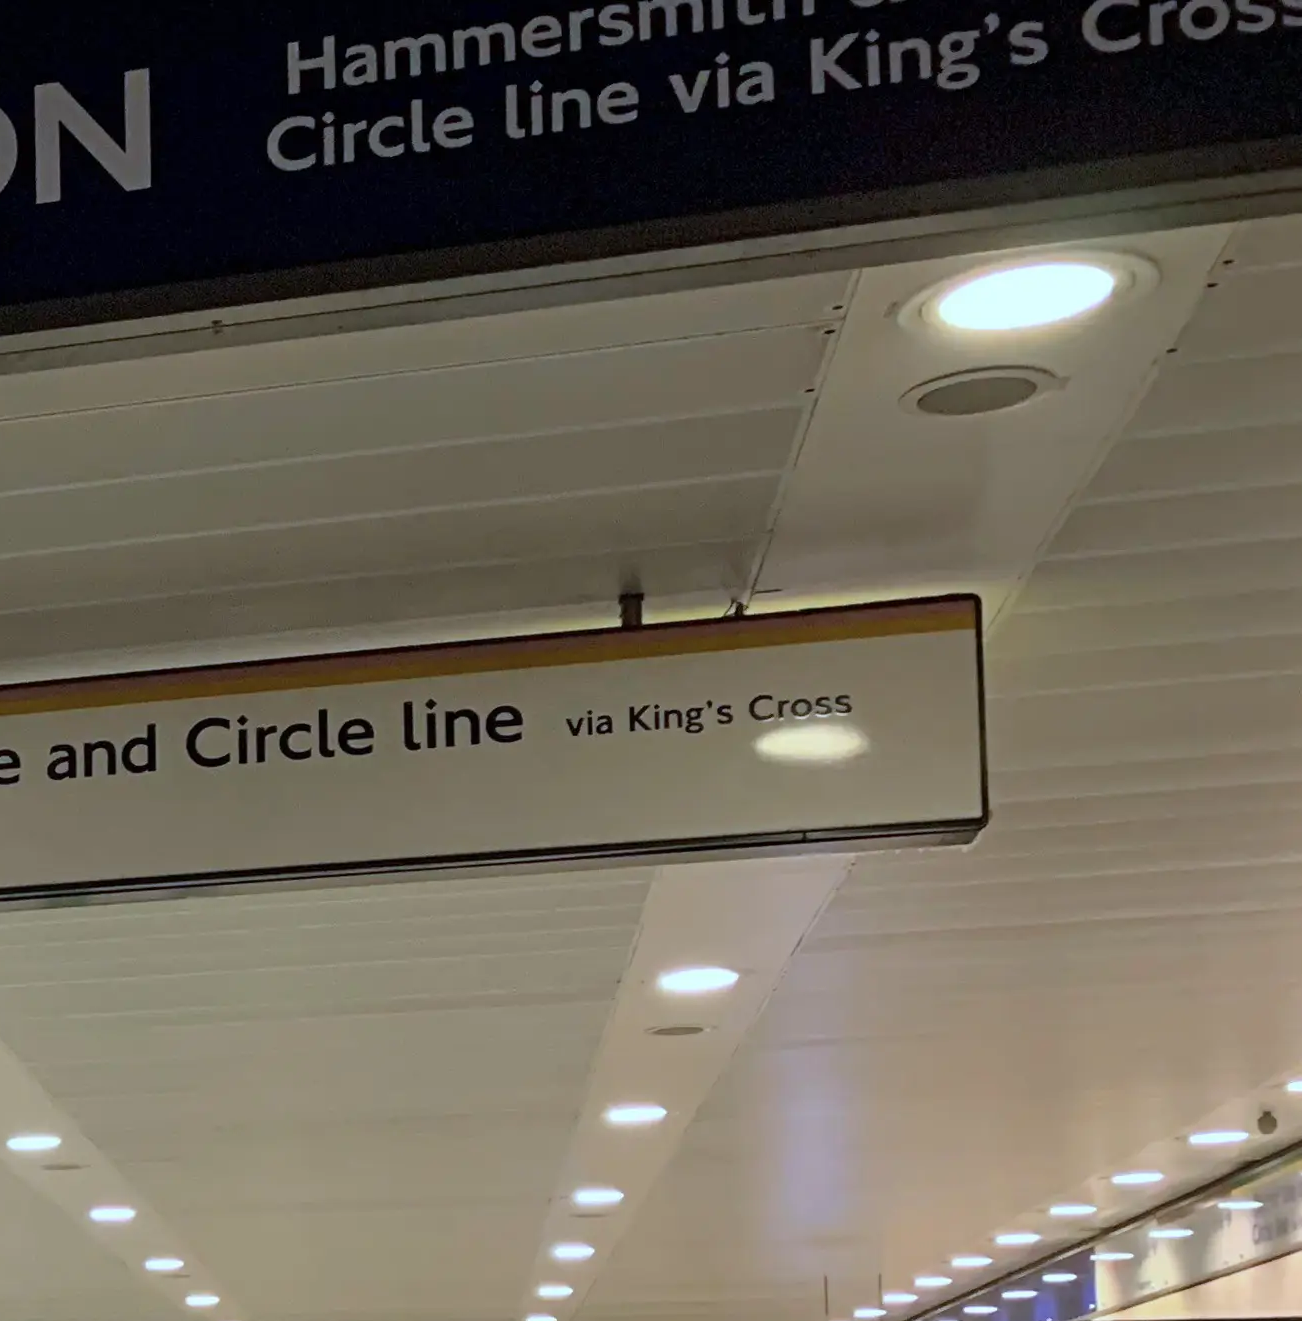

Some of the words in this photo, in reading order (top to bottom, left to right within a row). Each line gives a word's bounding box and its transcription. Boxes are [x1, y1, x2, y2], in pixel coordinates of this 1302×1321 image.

[266, 99, 474, 172] Circle
[505, 80, 639, 139] line
[669, 51, 775, 114] via
[809, 12, 1050, 94] King's
[46, 723, 157, 781] and
[186, 709, 375, 769] Circle
[403, 698, 525, 752] line
[566, 709, 613, 737] via
[628, 699, 733, 734] King's
[749, 692, 853, 722] Cross
